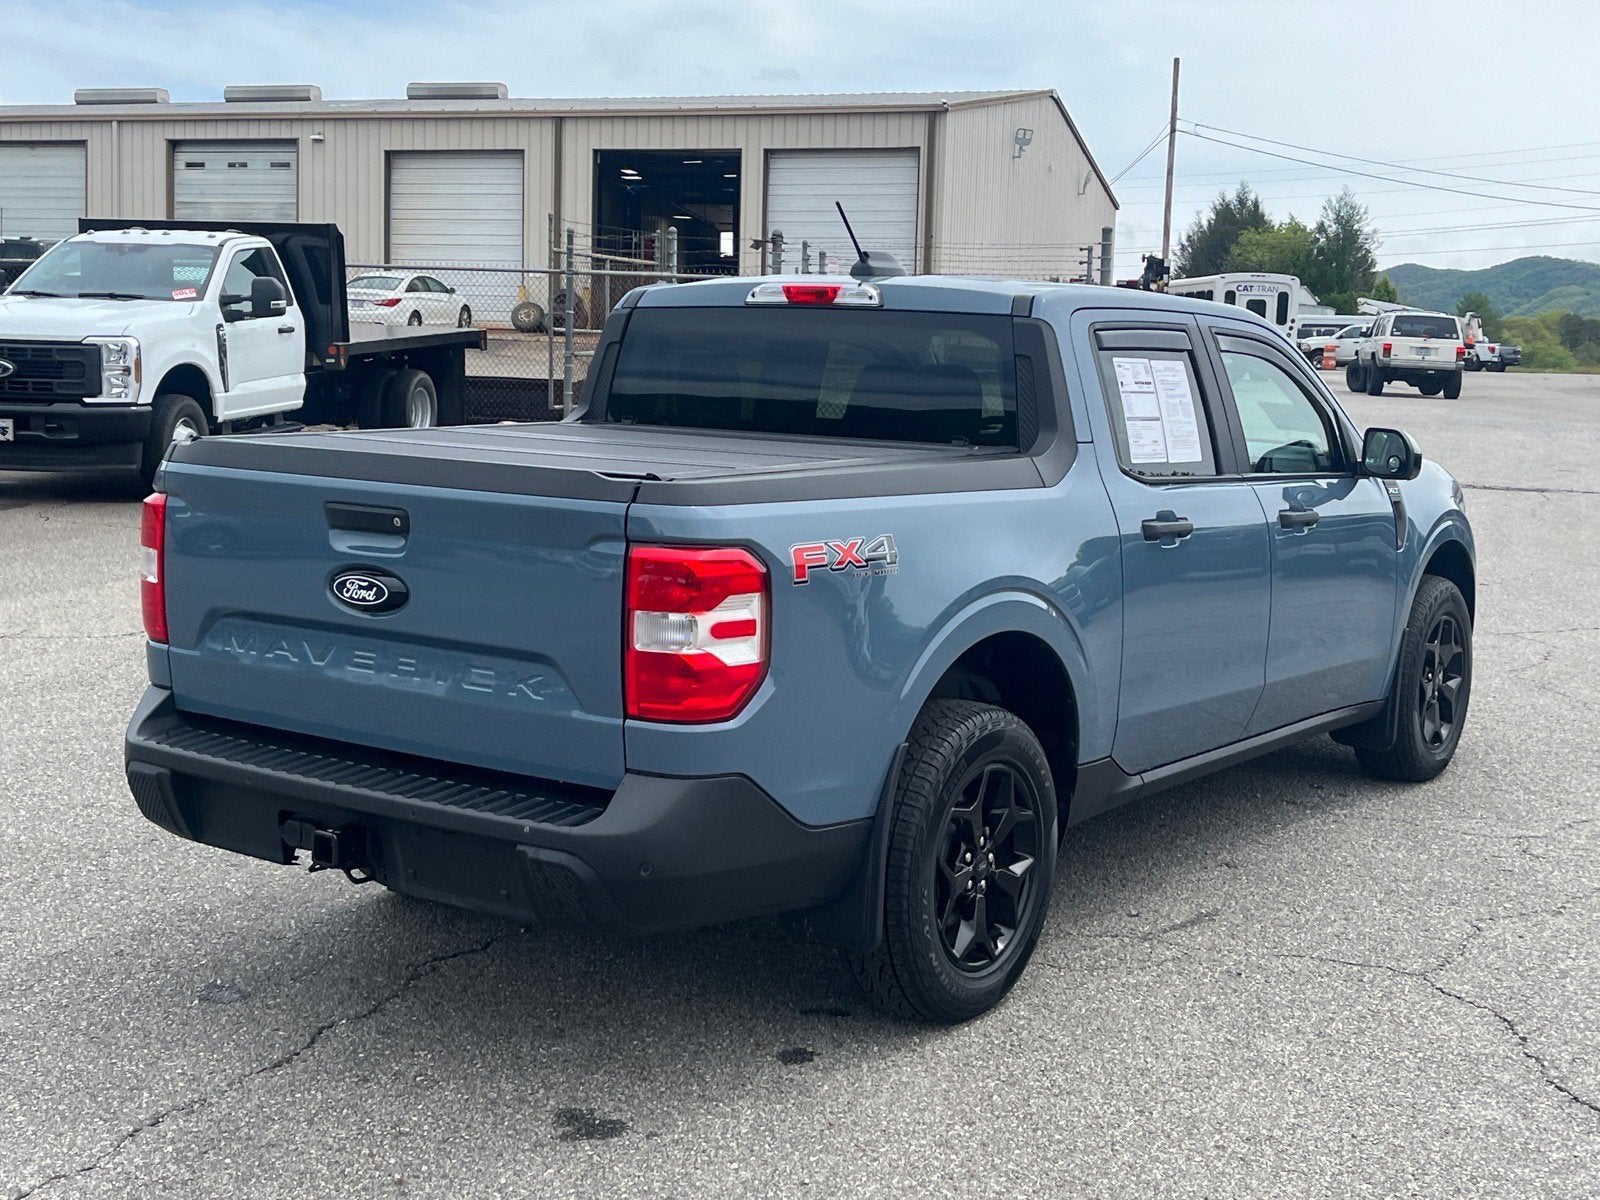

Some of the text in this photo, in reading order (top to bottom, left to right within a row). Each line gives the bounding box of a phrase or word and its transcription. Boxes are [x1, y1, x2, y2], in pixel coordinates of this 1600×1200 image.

[789, 533, 898, 586] FX4
[343, 579, 376, 601] Ford
[223, 631, 544, 700] MAVERICK
